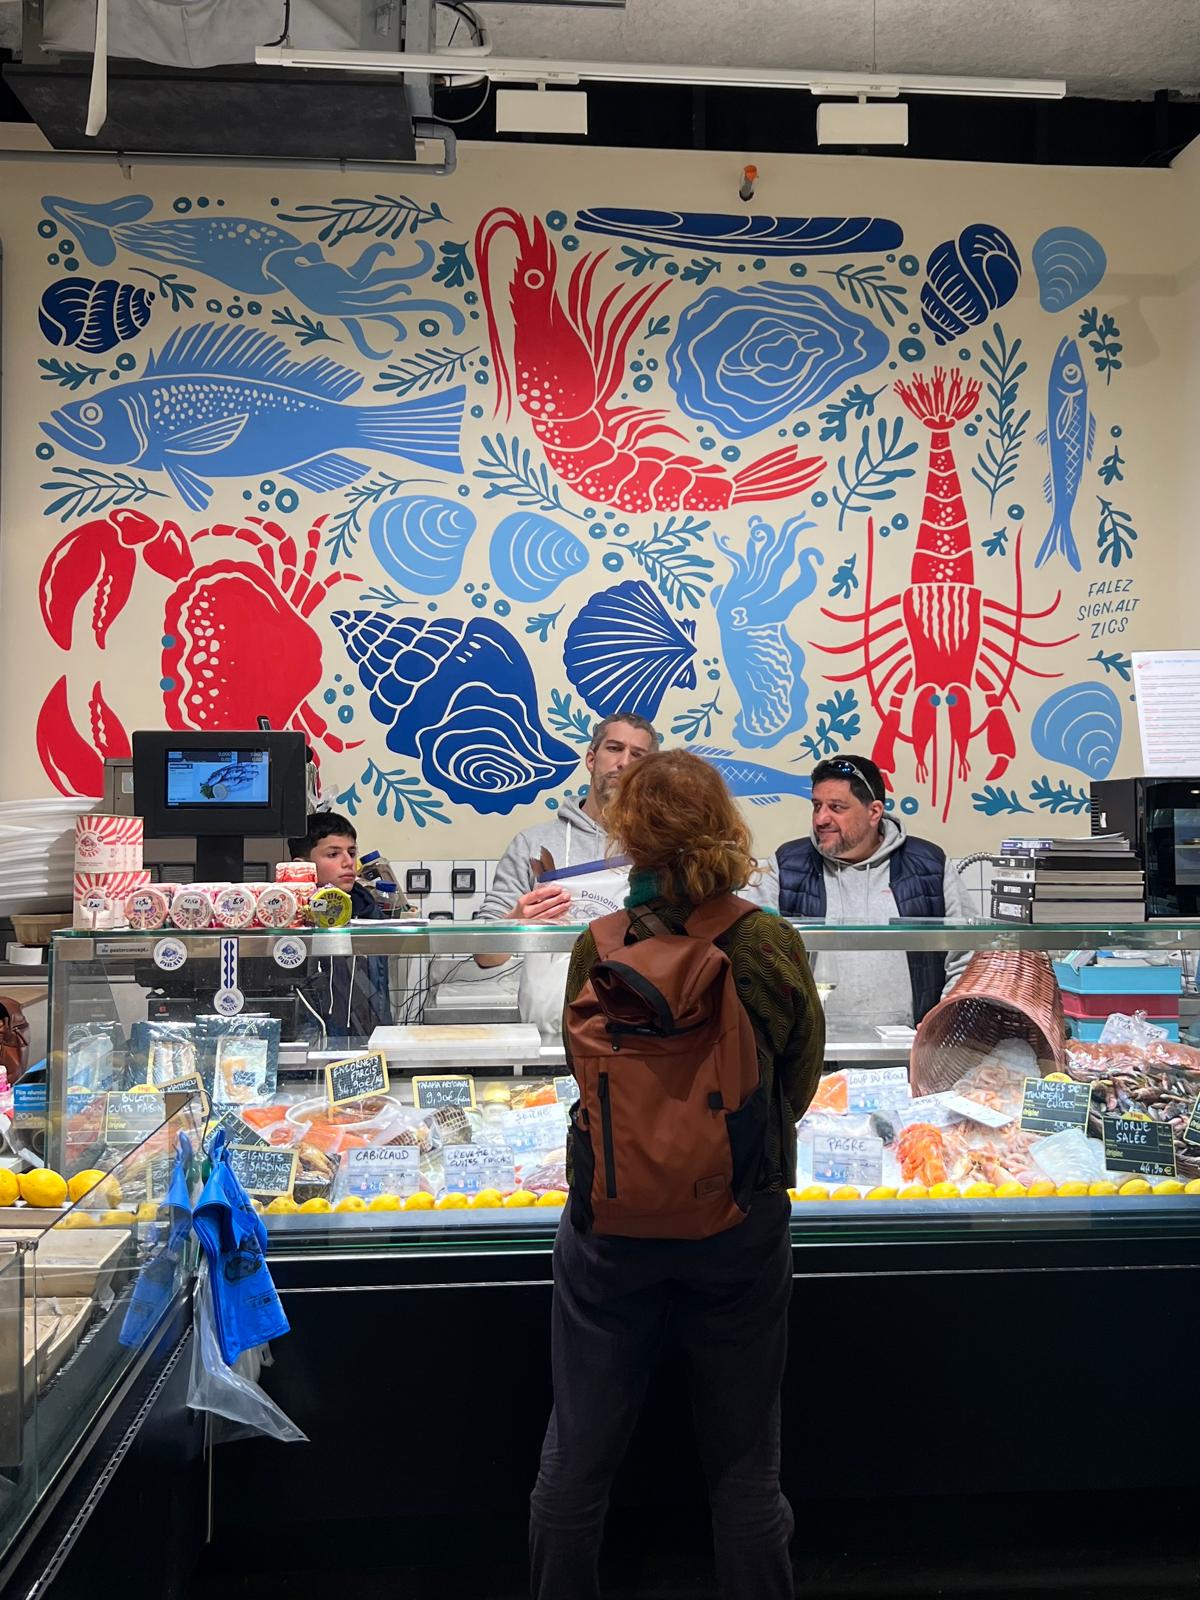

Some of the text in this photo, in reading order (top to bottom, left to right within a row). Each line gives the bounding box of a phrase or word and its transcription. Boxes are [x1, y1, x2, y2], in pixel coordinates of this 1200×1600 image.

[1088, 579, 1133, 597] FALEZ
[1091, 617, 1128, 638] ZICS
[130, 911, 163, 928] PIATE
[174, 911, 203, 928] PIRTE
[258, 907, 290, 924] PIRTE
[1115, 1120, 1151, 1132] MORUE
[826, 1137, 867, 1152] PAGRE
[1116, 1131, 1147, 1144] SALÉE
[232, 1150, 284, 1161] BEIGNETS
[355, 1149, 409, 1161] CABILLAUD
[232, 1161, 291, 1172] DE SARDINES
